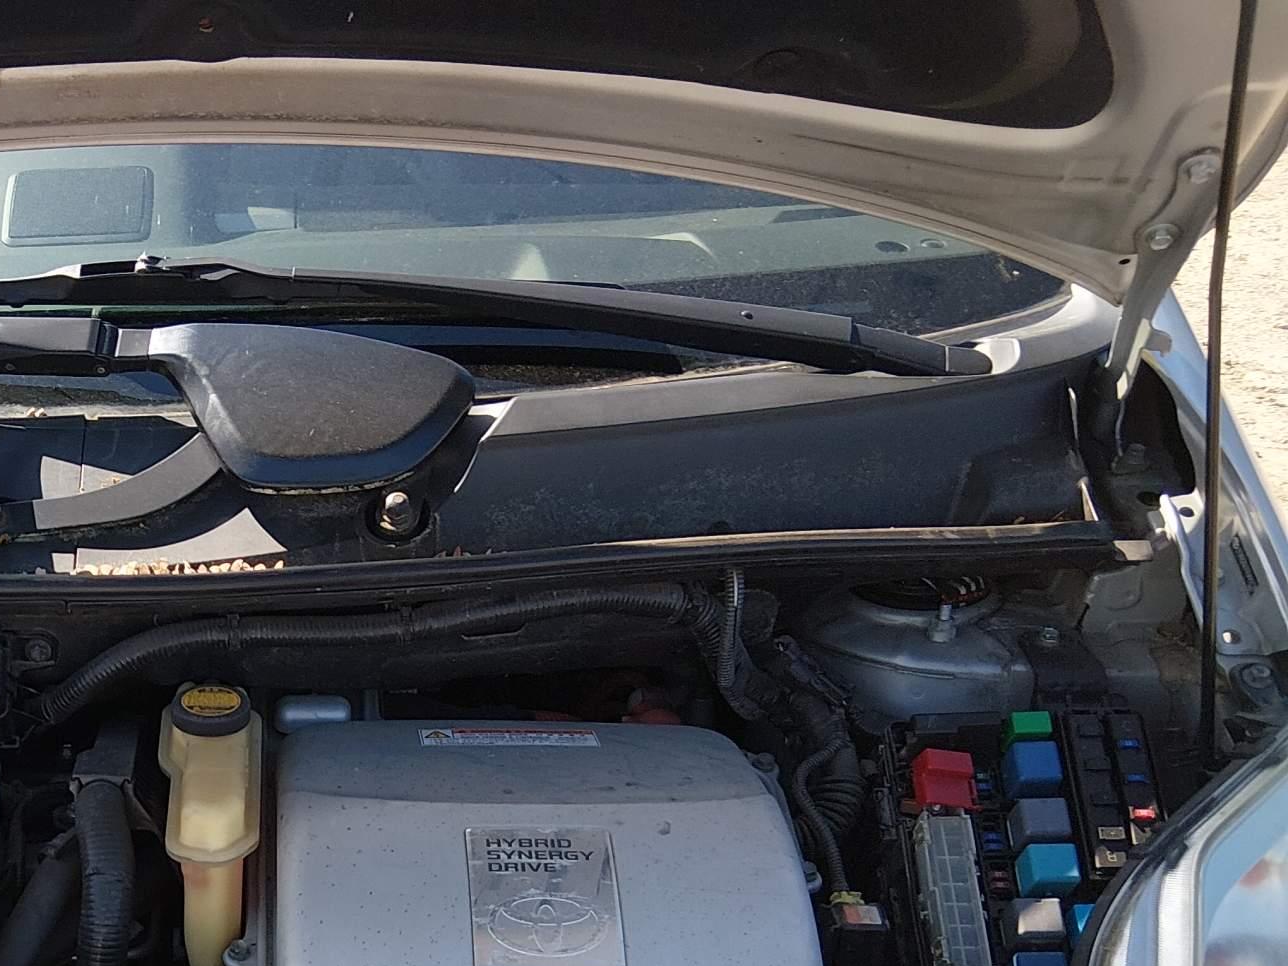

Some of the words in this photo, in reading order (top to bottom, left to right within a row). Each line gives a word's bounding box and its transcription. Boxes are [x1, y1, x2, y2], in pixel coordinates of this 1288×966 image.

[486, 838, 572, 848] HYBRID
[487, 850, 594, 861] SYNERGY
[488, 862, 557, 872] DRIVE
